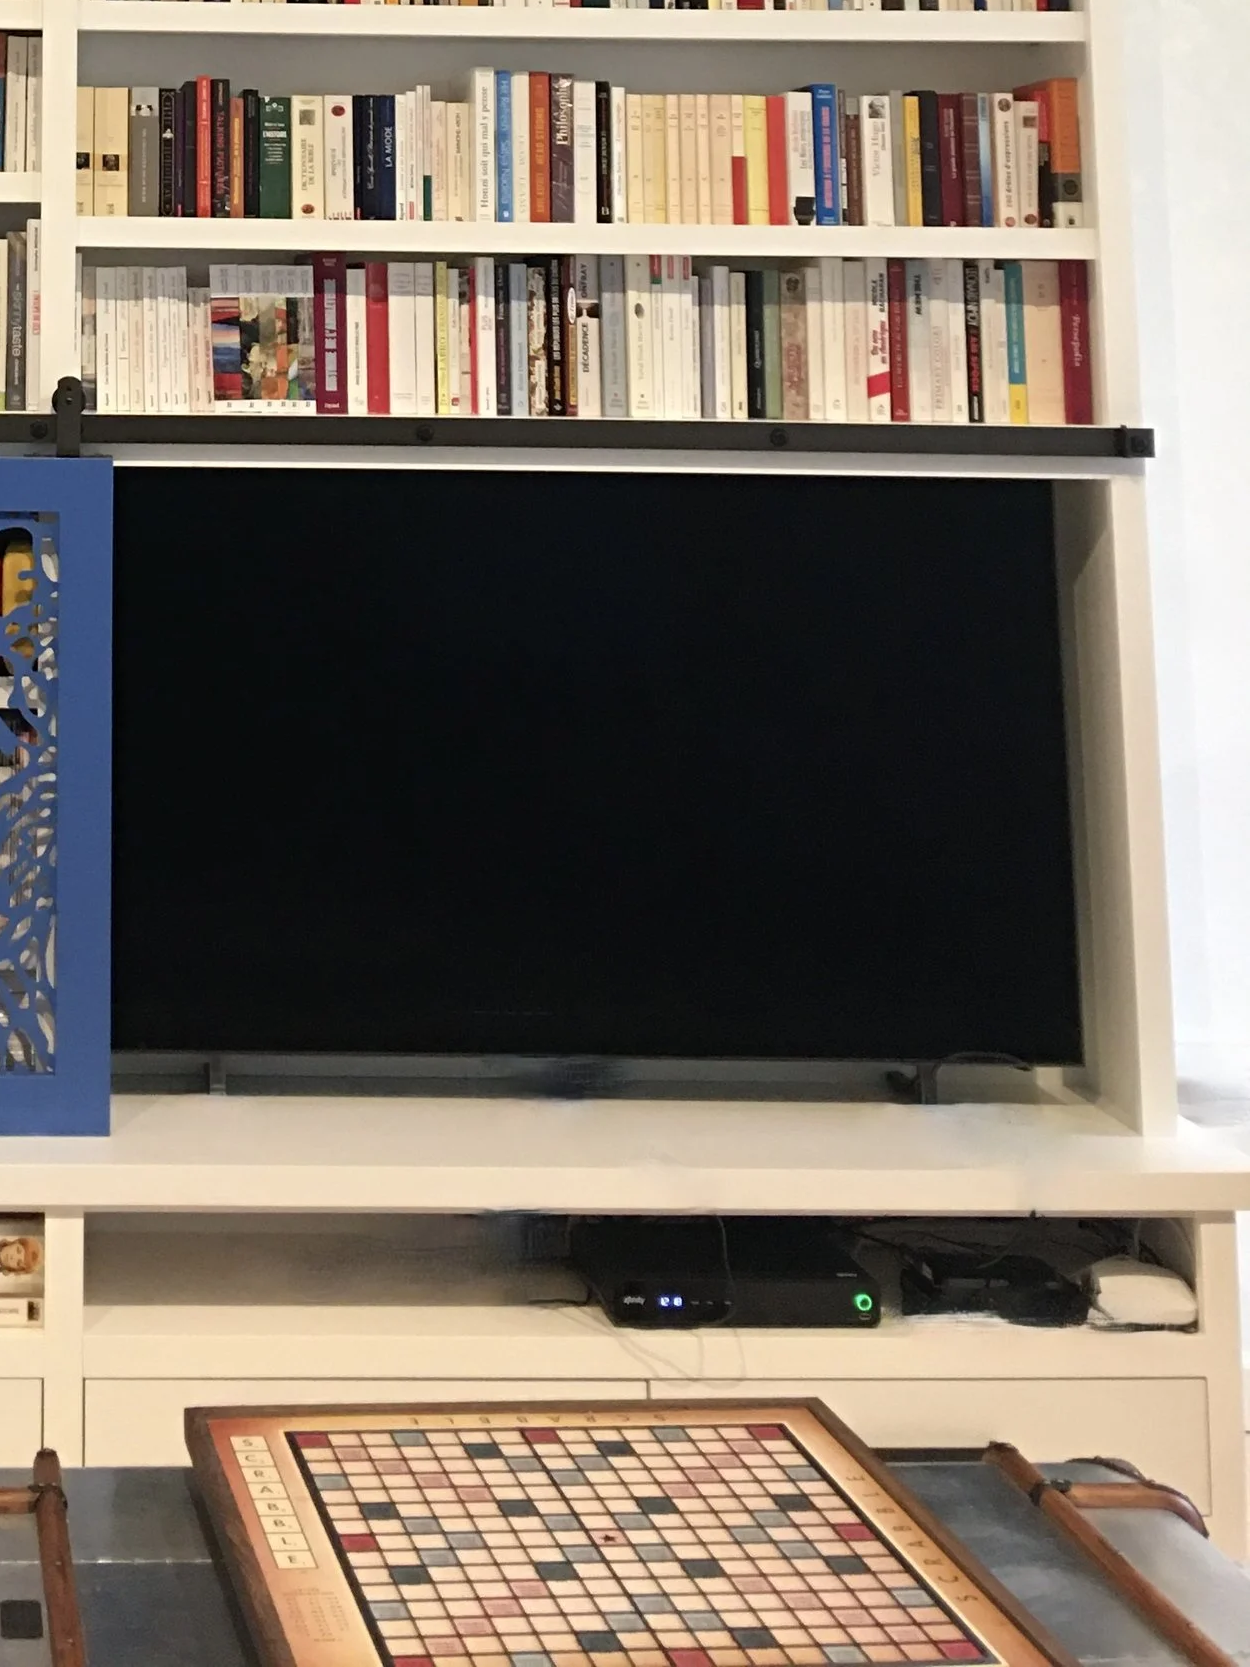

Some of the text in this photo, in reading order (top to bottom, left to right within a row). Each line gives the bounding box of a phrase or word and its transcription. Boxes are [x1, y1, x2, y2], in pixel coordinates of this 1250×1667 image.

[480, 87, 492, 113] pense
[500, 80, 510, 94] Hit
[384, 127, 393, 167] LA MODE
[479, 122, 489, 140] mal
[870, 121, 882, 148] Hugo
[214, 110, 226, 195] TALKING PICTURES
[480, 142, 491, 157] qui
[480, 160, 490, 179] soit
[480, 182, 489, 208] Honni
[579, 263, 589, 299] ONFRAY
[914, 274, 923, 315] THE NEW
[11, 291, 24, 357] skinnytaste
[1071, 313, 1083, 367] Persepolis
[581, 322, 590, 373] DÉCADENCE
[933, 367, 943, 410] PRIMARY
[971, 358, 980, 393] SPOCK
